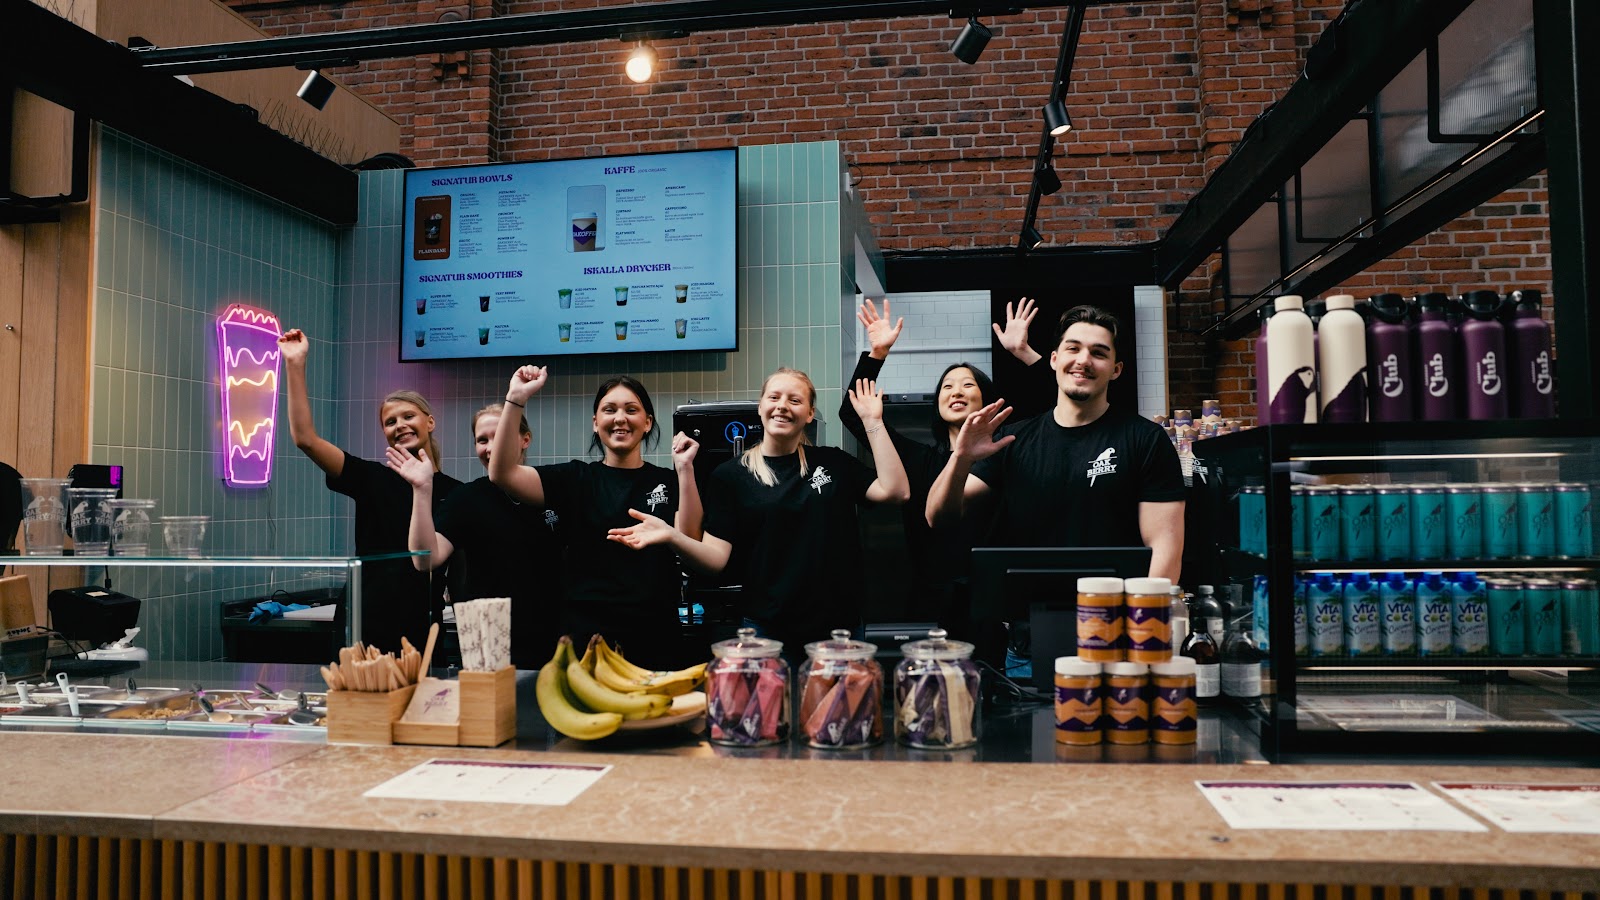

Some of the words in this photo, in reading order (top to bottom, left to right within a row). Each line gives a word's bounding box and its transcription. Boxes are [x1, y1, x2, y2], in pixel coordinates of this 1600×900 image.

[604, 165, 636, 175] KAFFE
[431, 175, 478, 187] SIGNATUR
[479, 173, 513, 184] BOWLS
[583, 265, 625, 275] ISKALLA
[626, 263, 671, 273] DRYCKER
[418, 273, 466, 283] SIGNATUR
[466, 270, 523, 280] SMOOTHIES
[1383, 353, 1404, 398] Club
[1429, 353, 1449, 398] Club
[1482, 351, 1502, 396] Club
[1536, 350, 1553, 395] Club
[1092, 459, 1111, 468] OAK
[1086, 464, 1117, 476] BERRY
[810, 475, 832, 489] BERRY
[812, 472, 825, 483] OAK
[646, 496, 669, 505] BERRY
[1317, 603, 1340, 614] VITA
[1353, 603, 1377, 614] VITA
[1388, 602, 1412, 613] VITA
[1425, 602, 1449, 613] VITA
[1458, 602, 1484, 613] VITA
